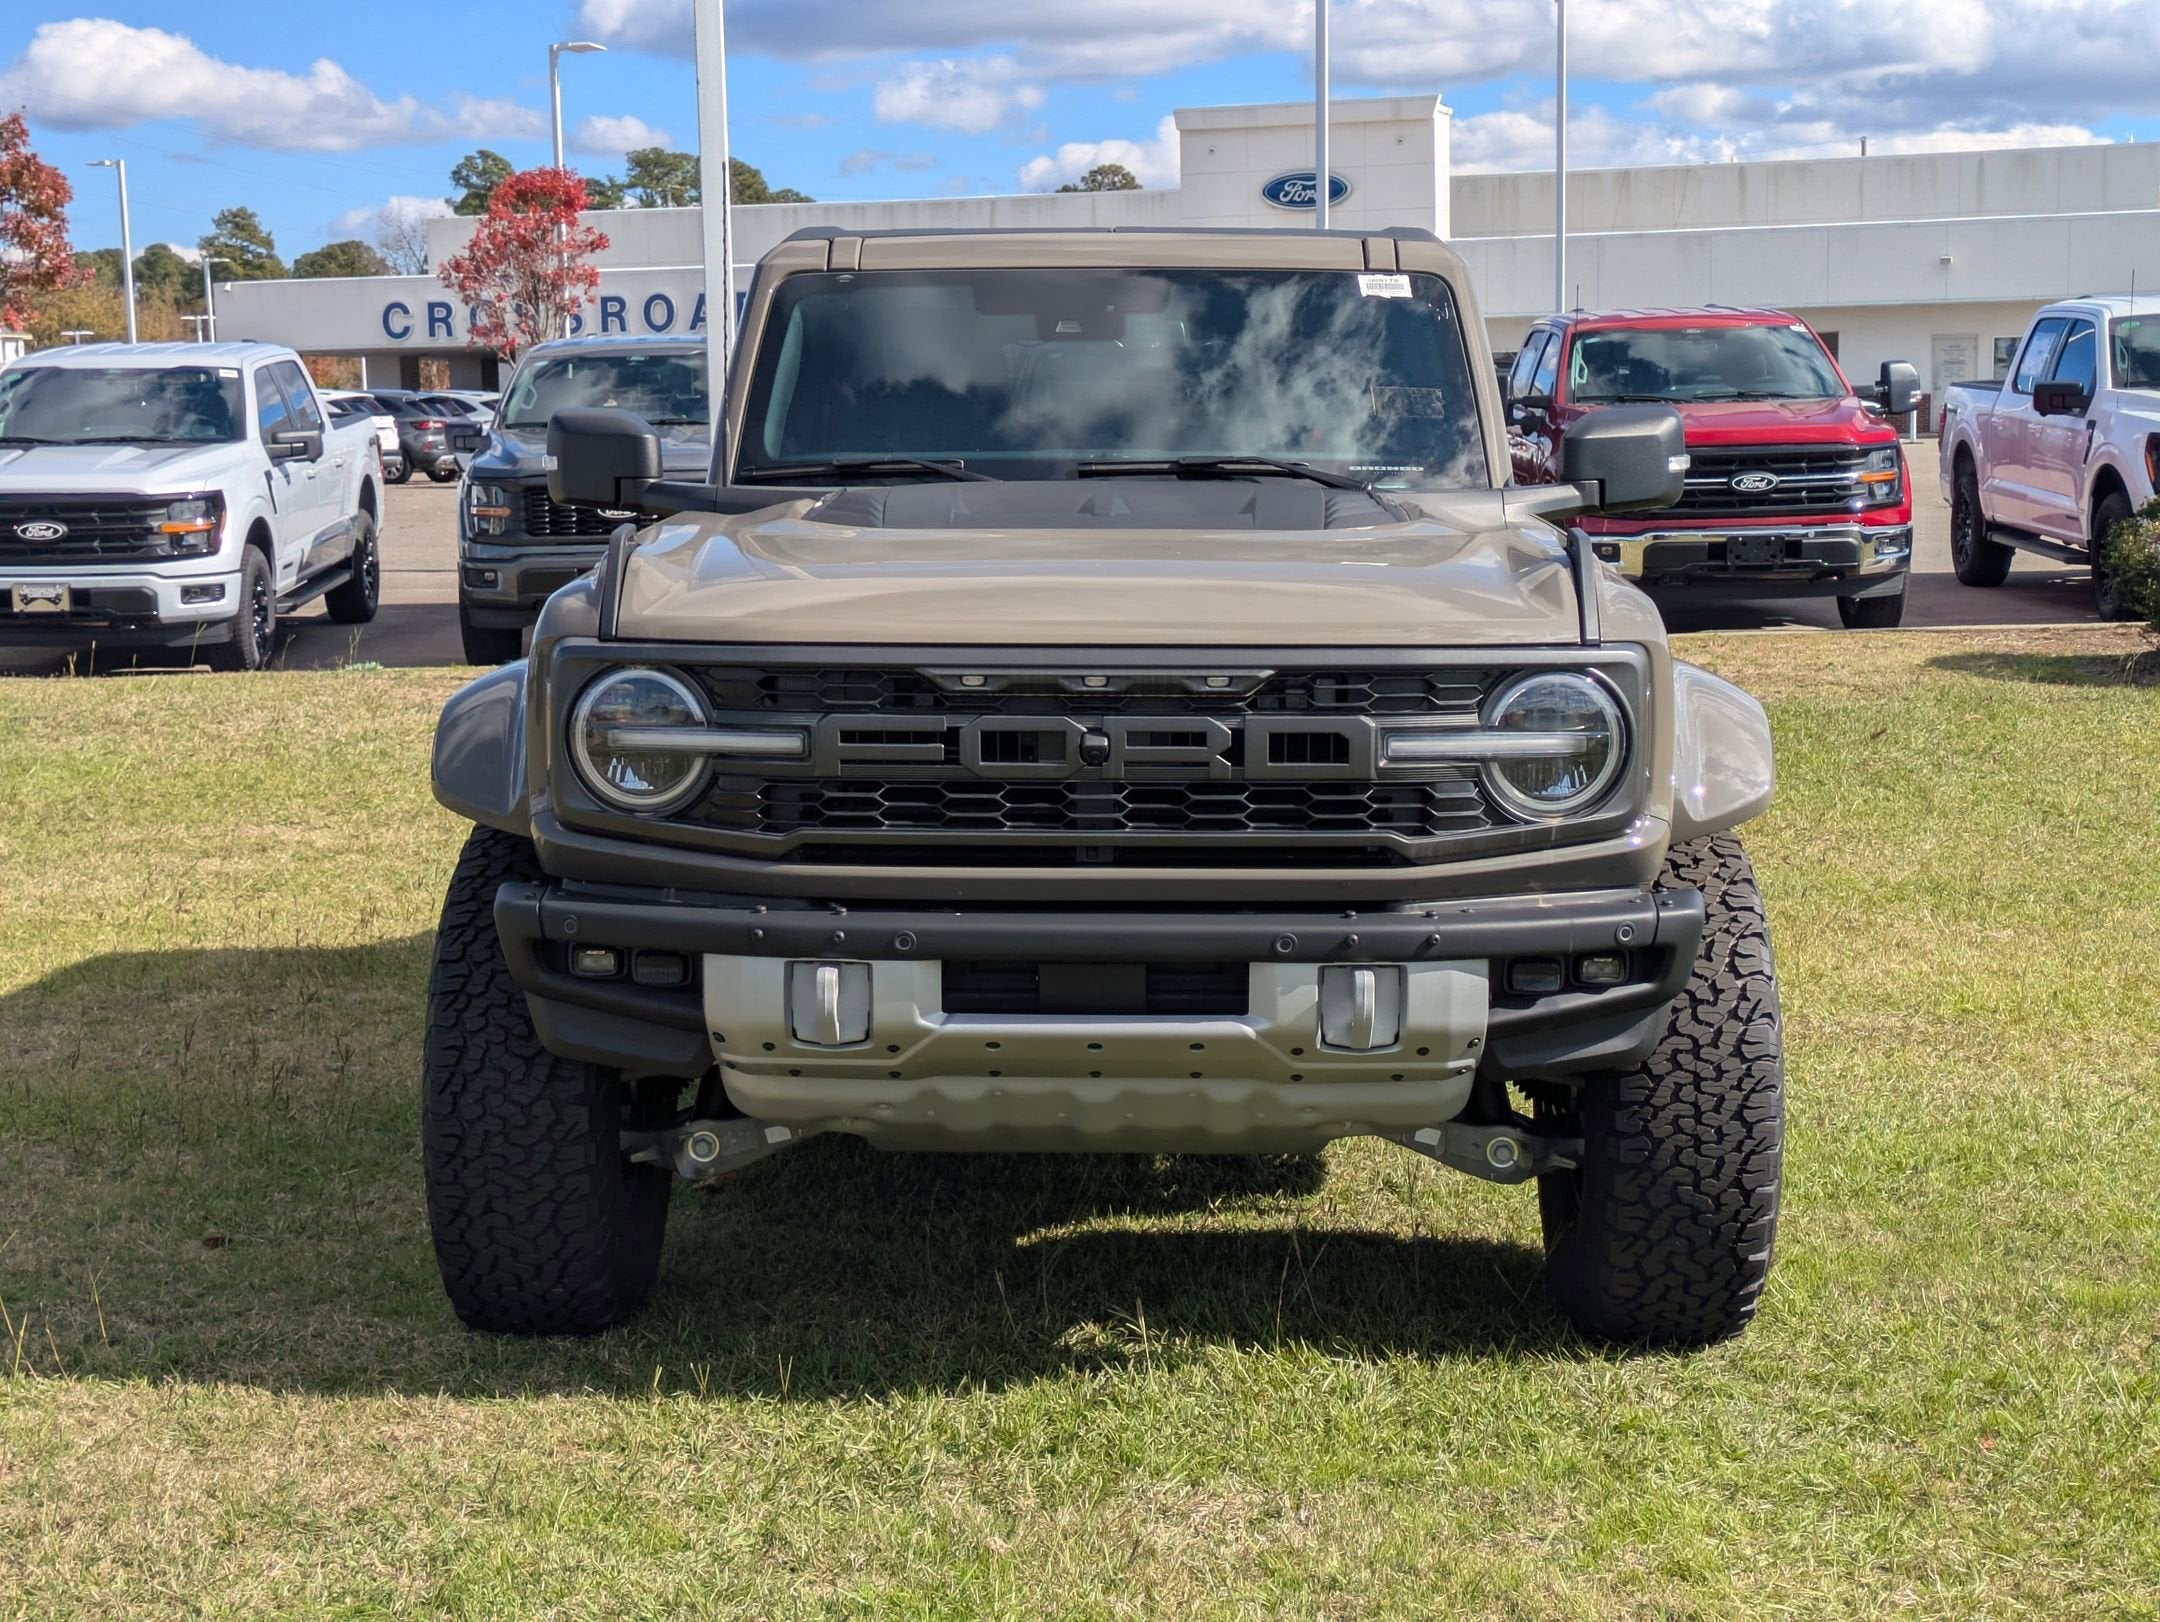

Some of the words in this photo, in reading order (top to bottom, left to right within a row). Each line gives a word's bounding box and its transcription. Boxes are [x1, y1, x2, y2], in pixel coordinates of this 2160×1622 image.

[1279, 180, 1318, 202] For
[382, 291, 747, 340] CRROA
[1740, 476, 1768, 488] Ford
[25, 525, 55, 537] Ford
[811, 713, 1379, 780] FORD
